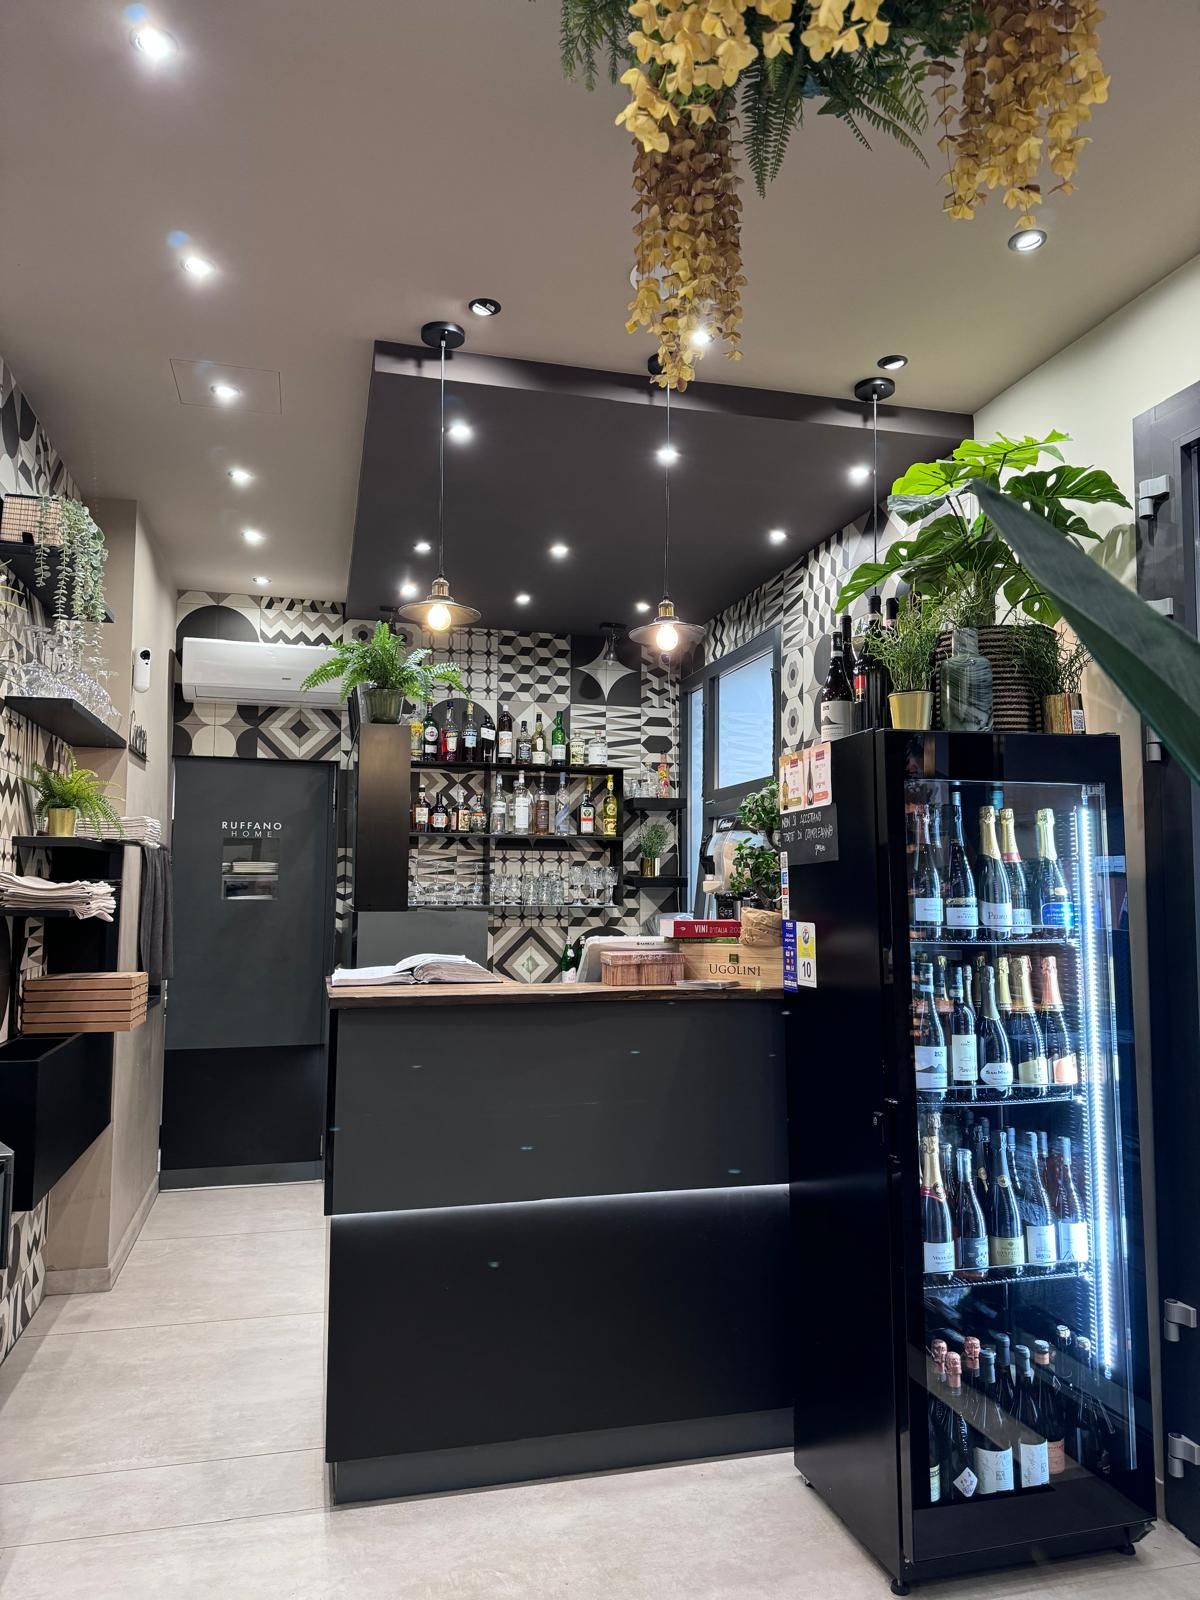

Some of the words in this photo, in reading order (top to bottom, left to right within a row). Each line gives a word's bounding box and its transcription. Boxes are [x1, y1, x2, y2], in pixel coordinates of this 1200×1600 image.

[221, 821, 282, 830] RUFFANO
[231, 830, 273, 838] HOME
[694, 924, 708, 933] VINI
[709, 963, 761, 977] UGOLINI
[801, 960, 812, 978] 10
